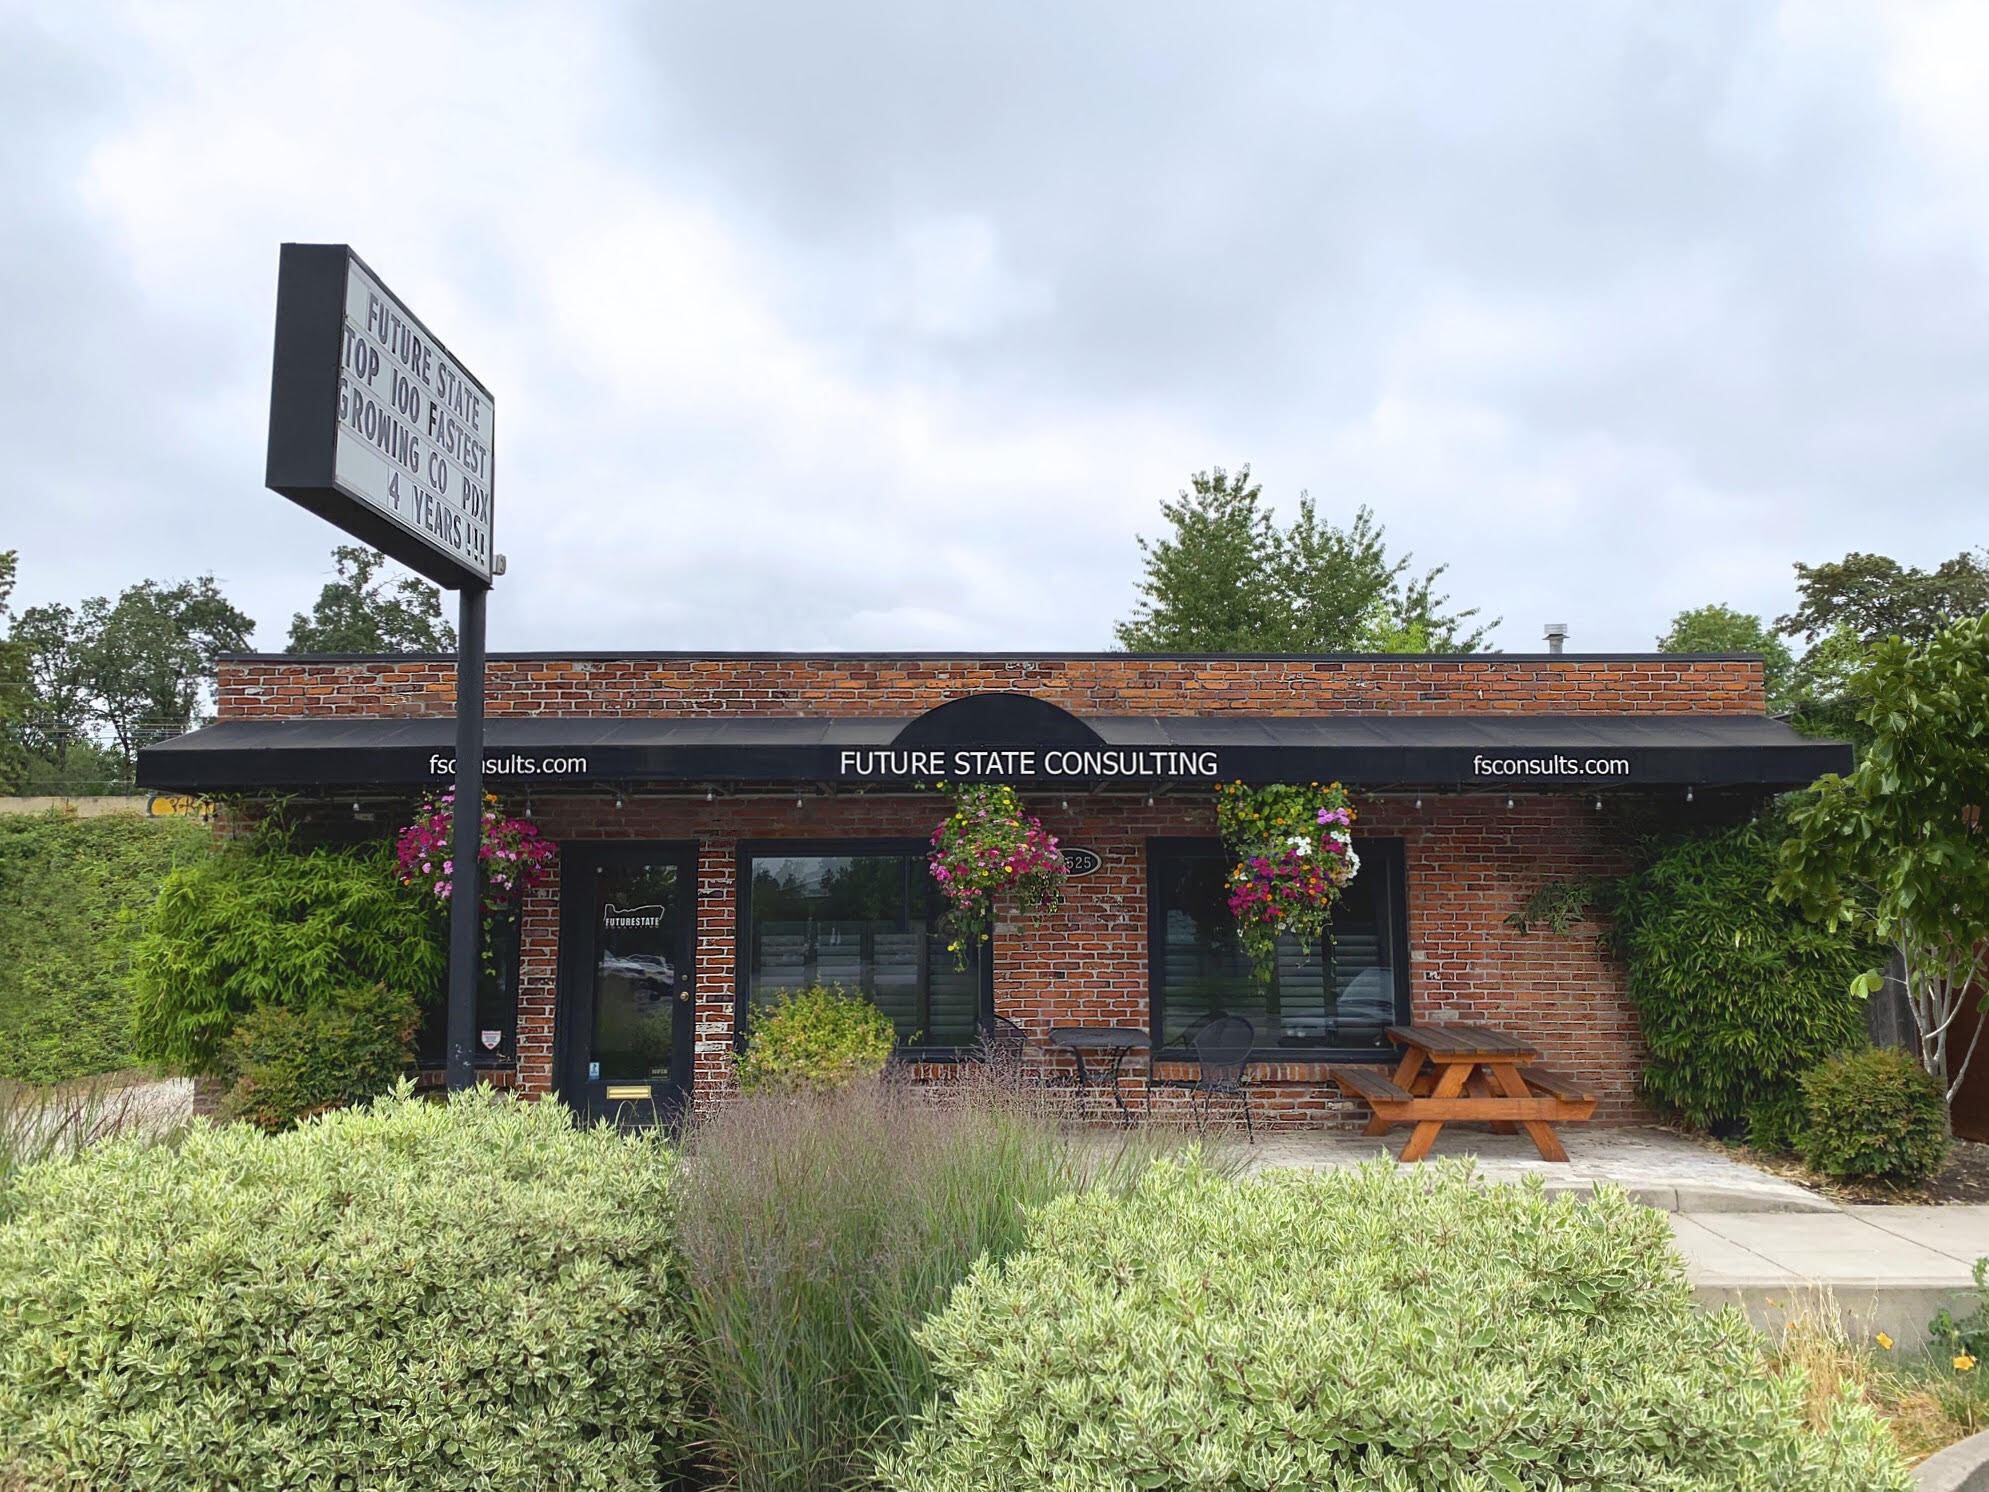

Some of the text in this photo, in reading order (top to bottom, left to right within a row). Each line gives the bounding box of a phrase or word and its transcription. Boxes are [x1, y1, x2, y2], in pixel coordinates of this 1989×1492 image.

[368, 293, 480, 431] FUTURE STATE
[344, 324, 487, 479] TOP 100 FASTEST
[339, 377, 489, 525] GROWING CO PDX
[389, 471, 400, 510] 4
[429, 754, 587, 774] fscsults.com
[841, 751, 1218, 775] FUTURE STATE CONSULTING
[1473, 755, 1630, 775] fsconsults.com
